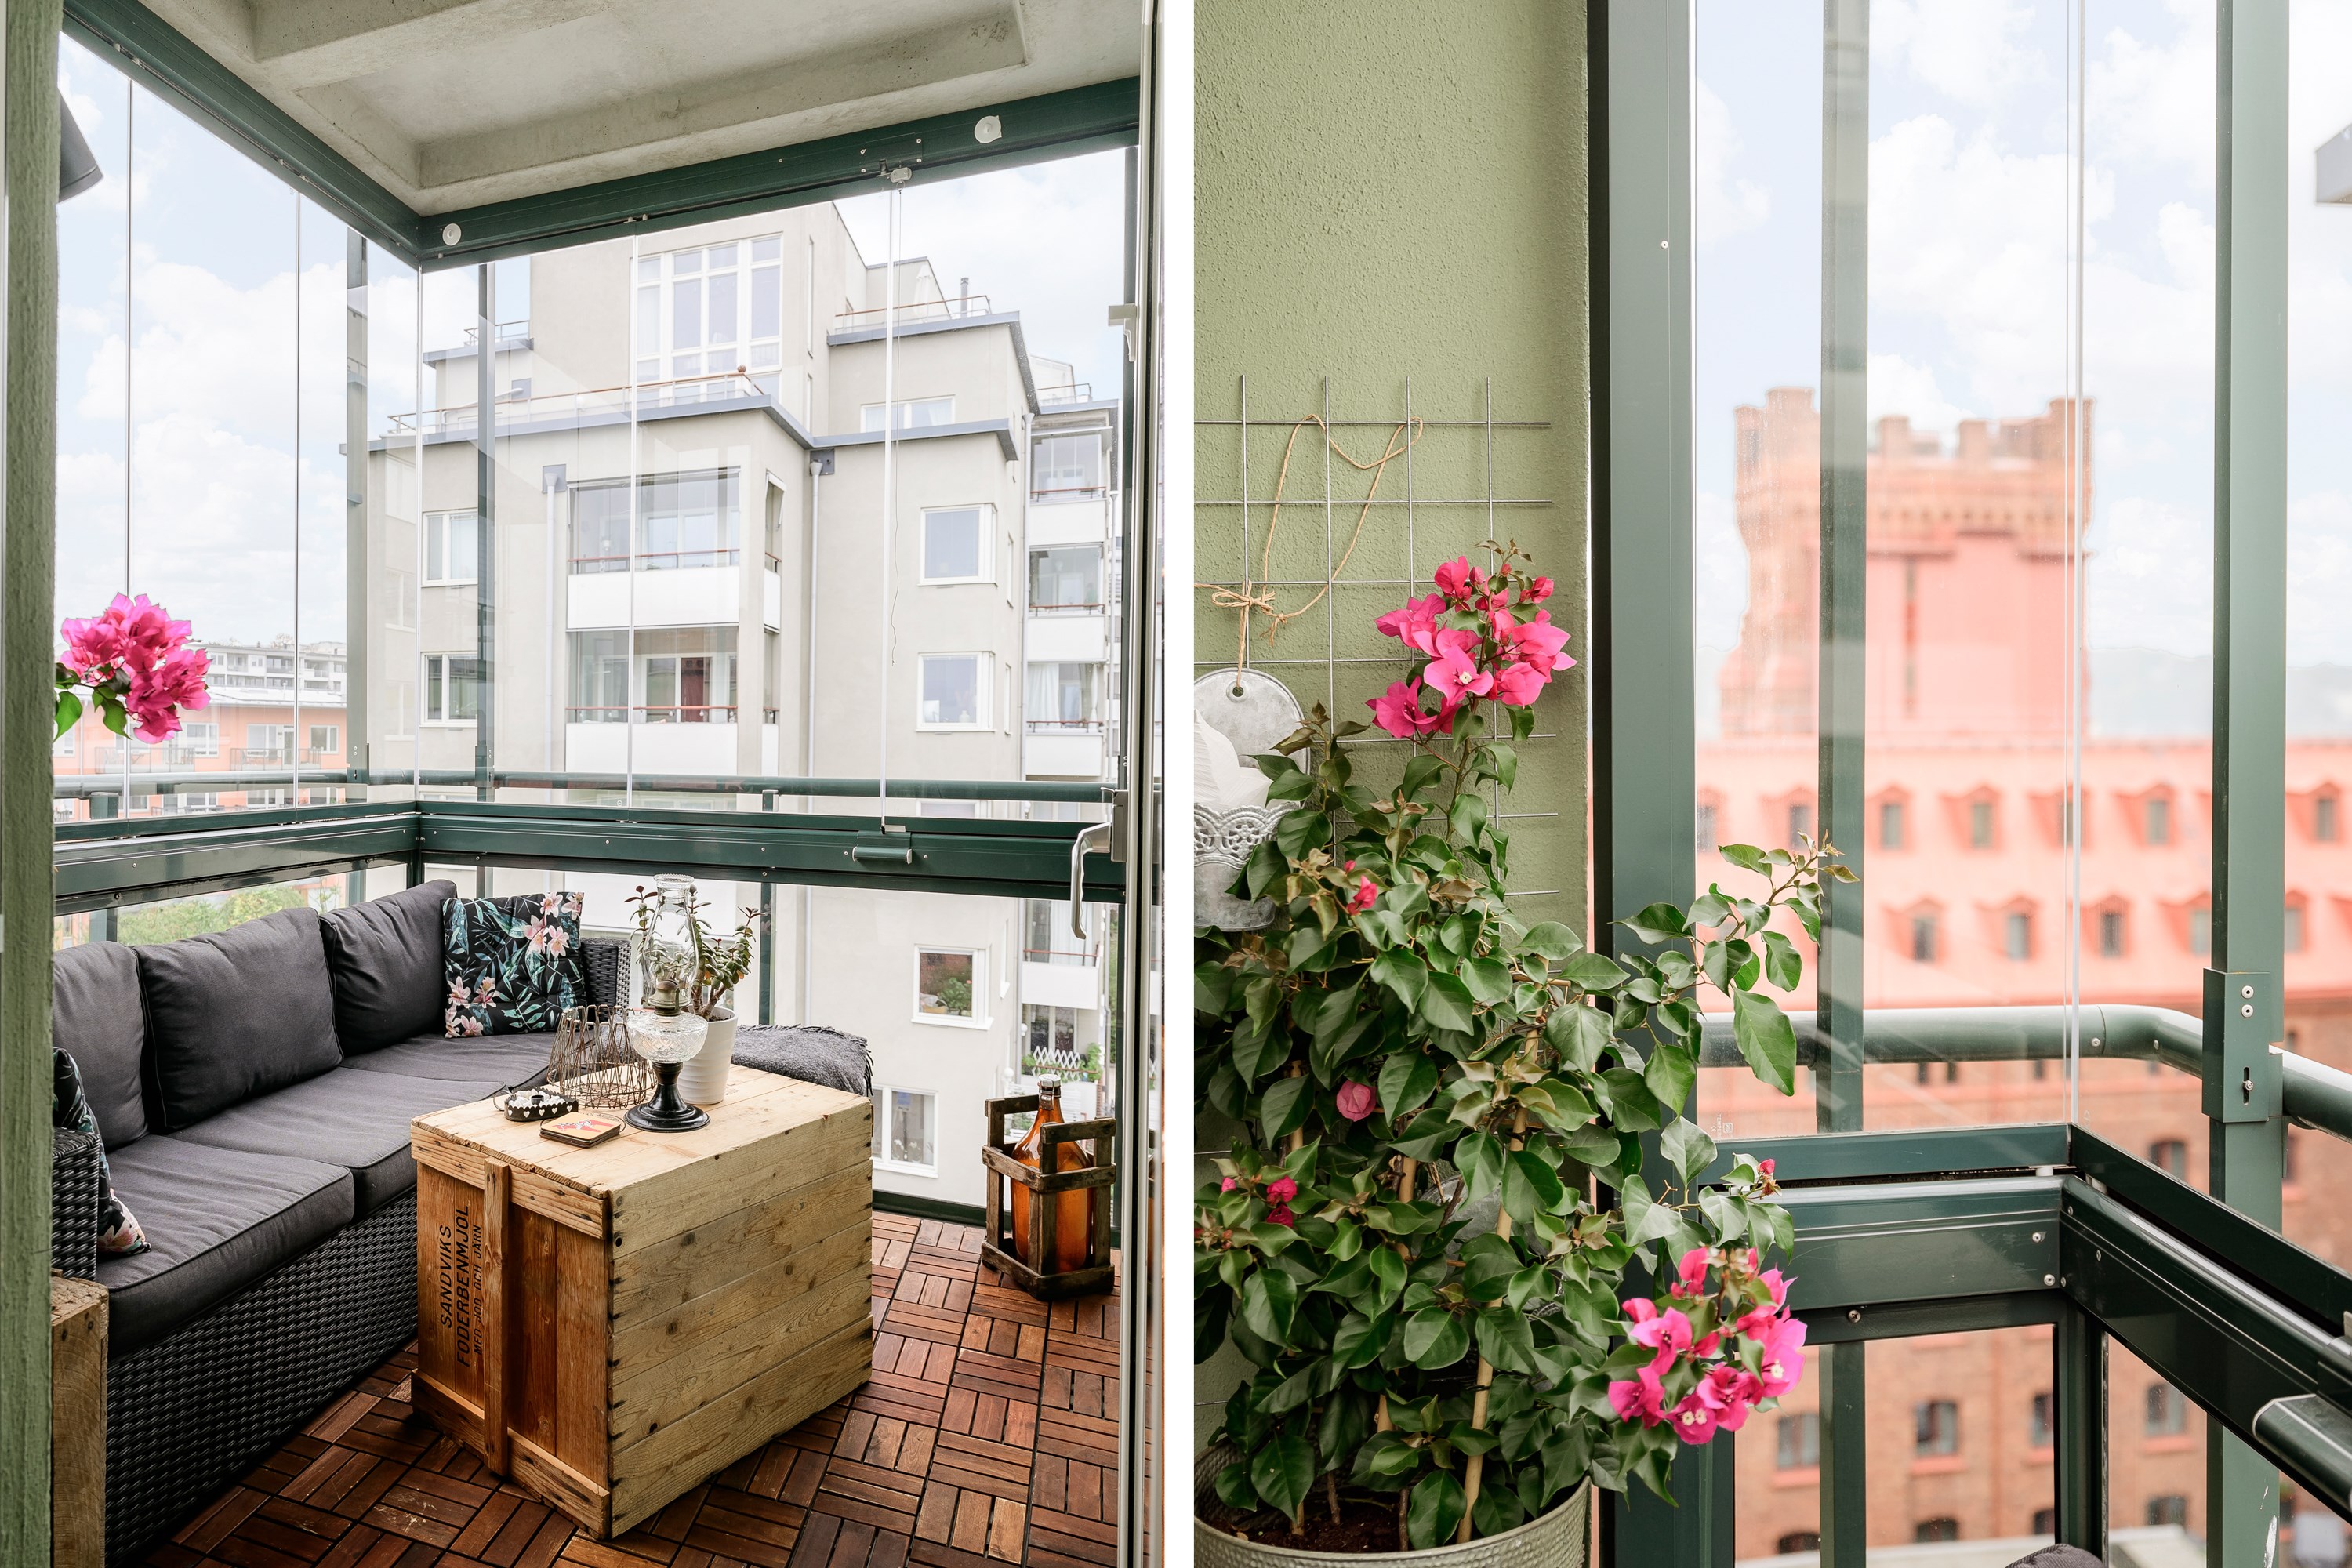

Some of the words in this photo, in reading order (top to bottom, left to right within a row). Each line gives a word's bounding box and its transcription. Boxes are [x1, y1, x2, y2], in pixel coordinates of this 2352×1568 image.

[472, 1225, 482, 1259] JÄRN
[439, 1225, 452, 1329] SANDVIKS
[455, 1206, 470, 1368] FODERBENMJÖL
[474, 1264, 482, 1291] OCH
[474, 1298, 483, 1323] JOD
[474, 1328, 483, 1356] MED
